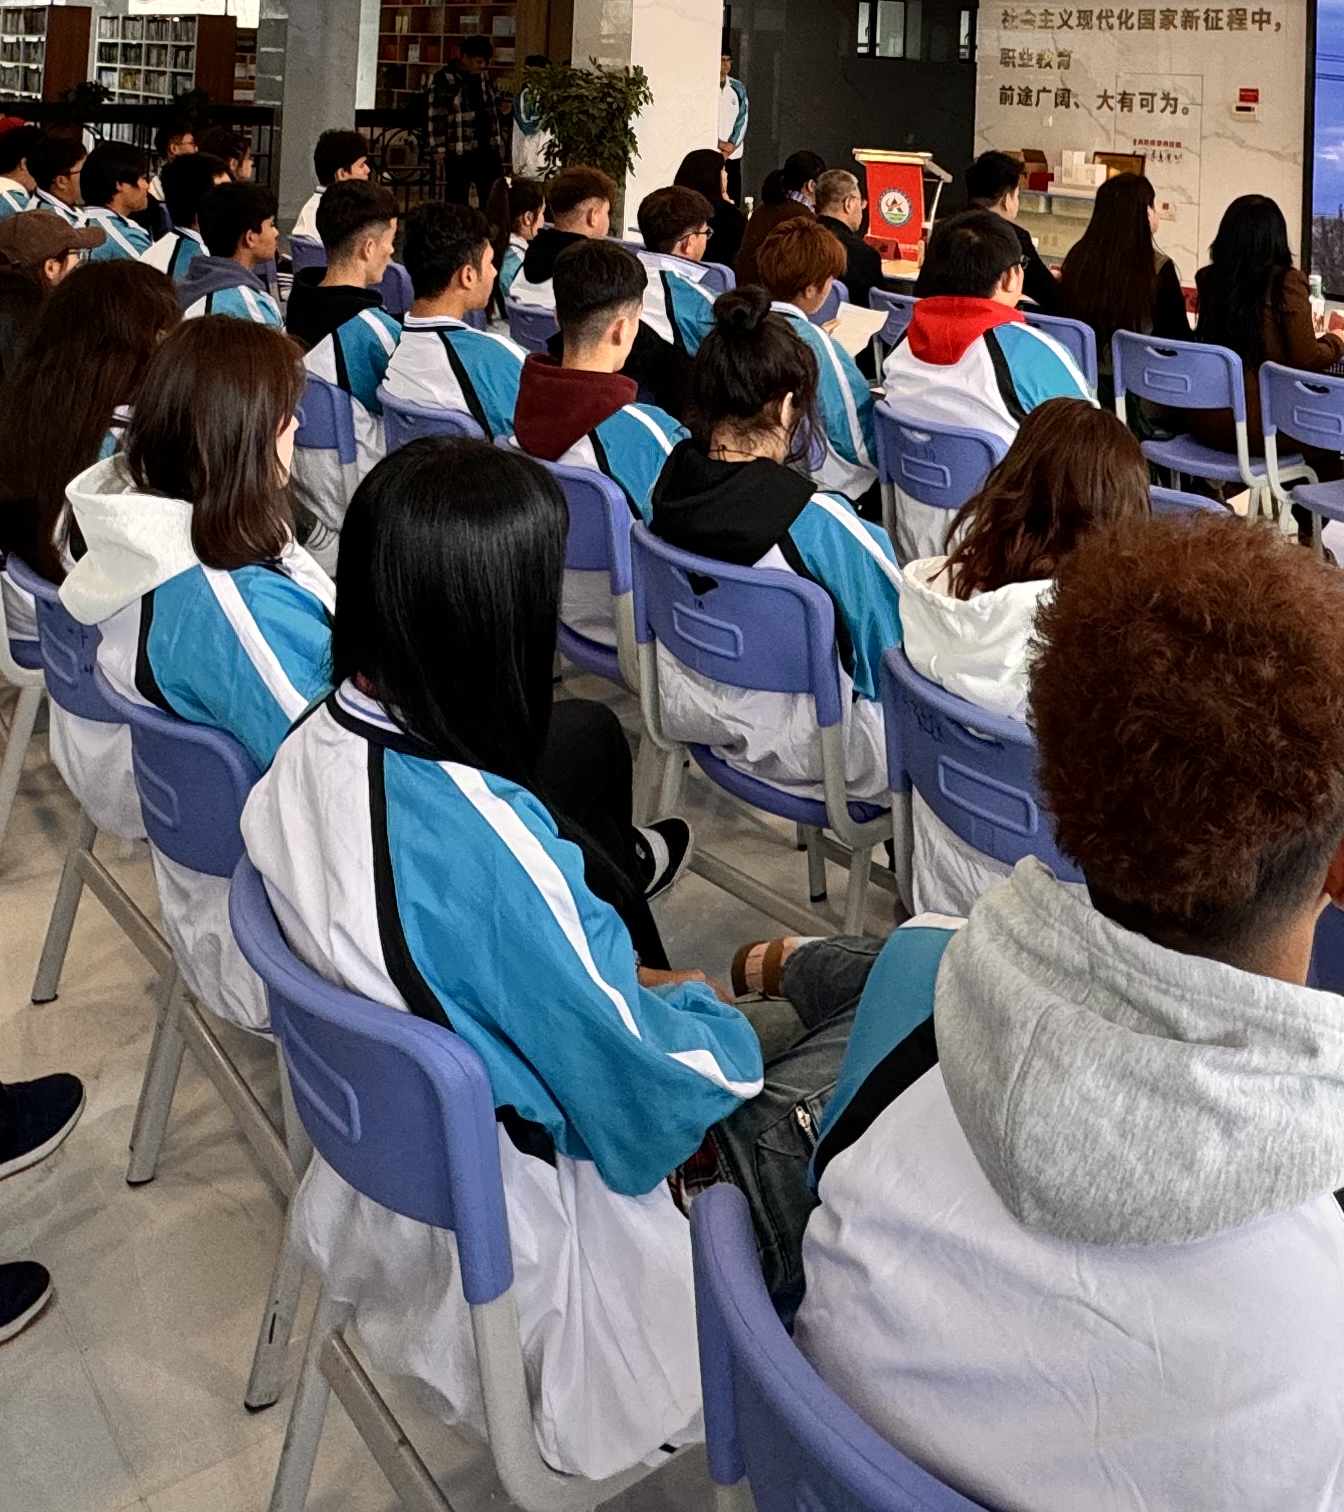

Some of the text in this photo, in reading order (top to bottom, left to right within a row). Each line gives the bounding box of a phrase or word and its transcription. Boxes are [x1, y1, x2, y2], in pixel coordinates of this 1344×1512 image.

[1001, 7, 1283, 33] 社会主义现代化国家新征程中，
[999, 46, 1073, 71] 职业教育
